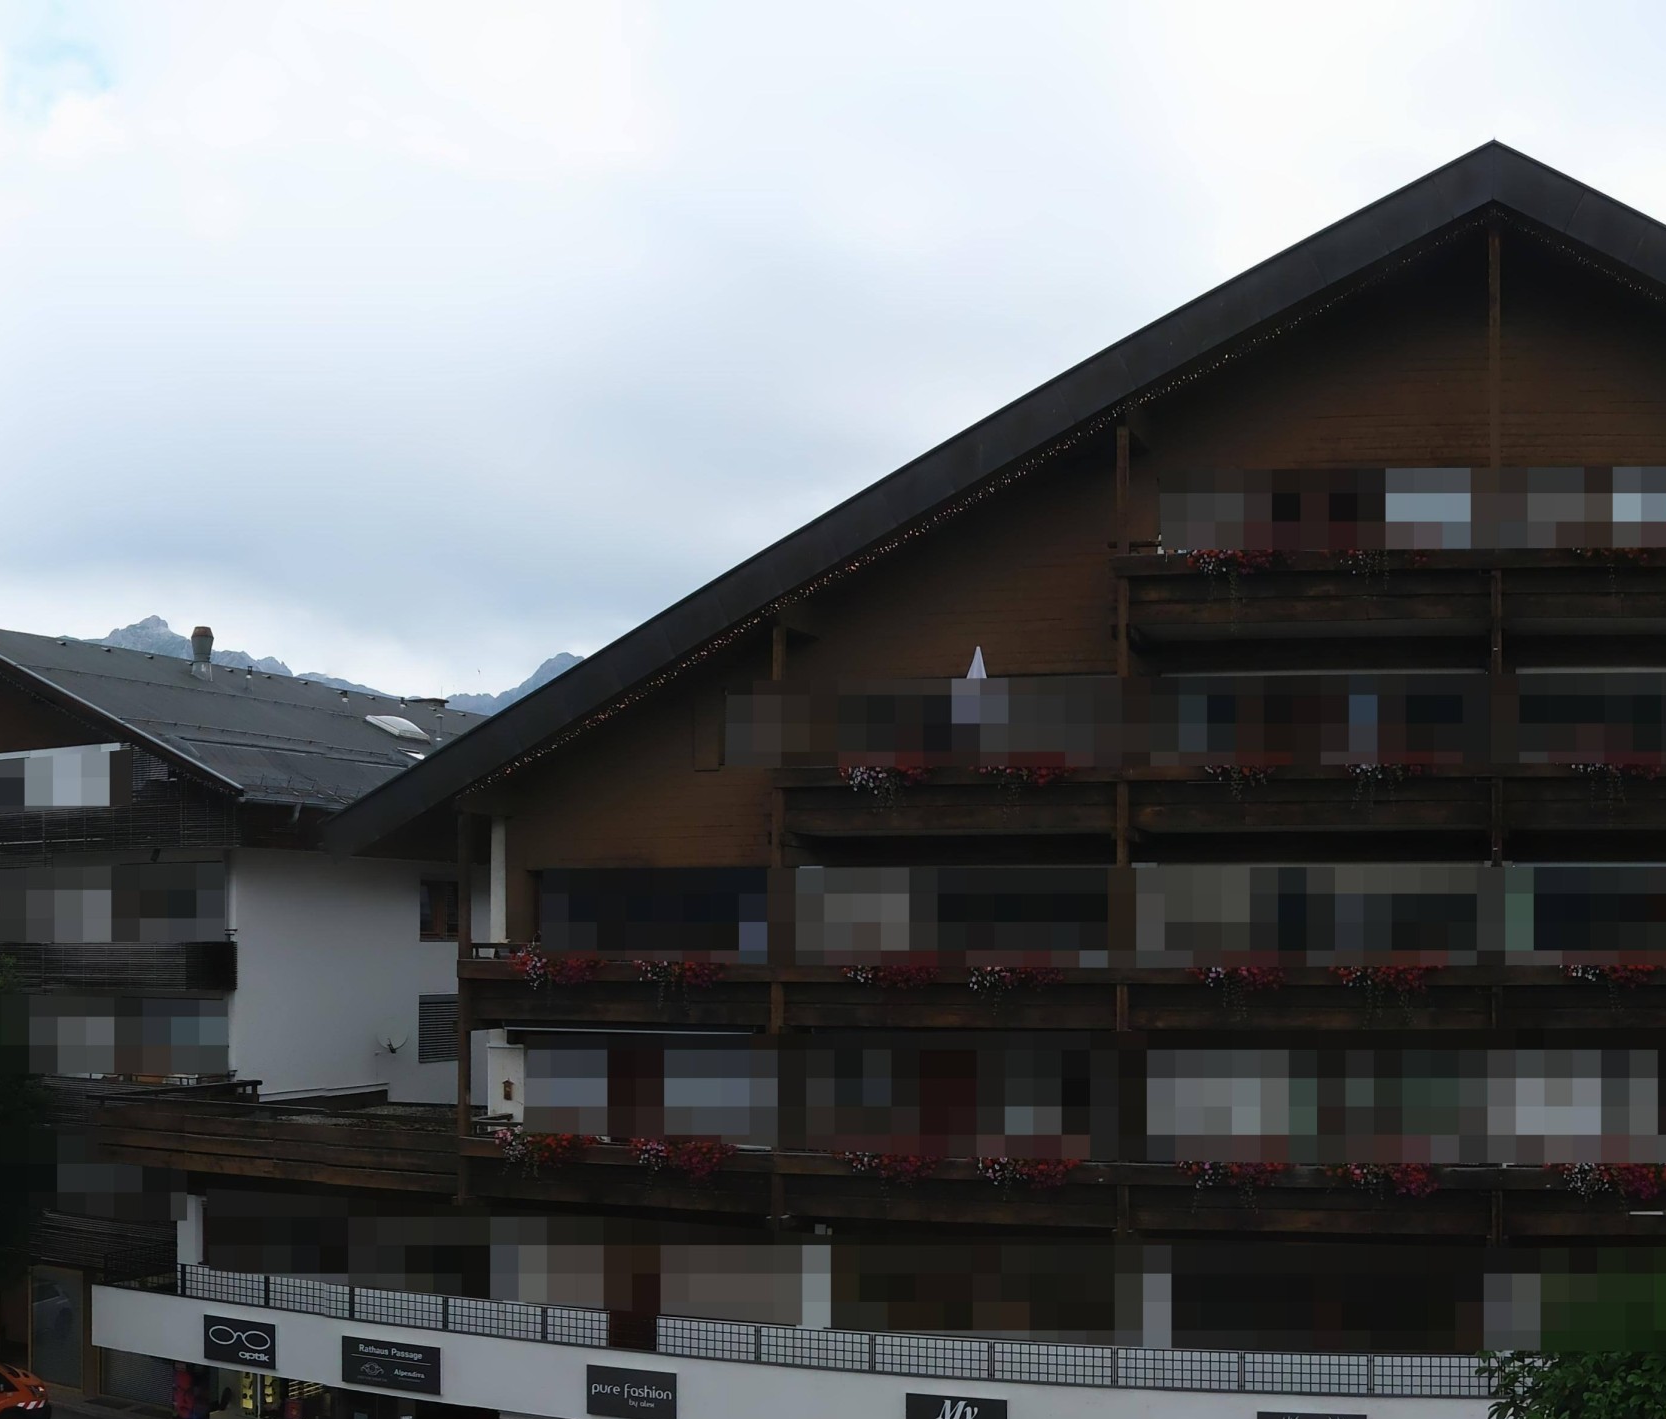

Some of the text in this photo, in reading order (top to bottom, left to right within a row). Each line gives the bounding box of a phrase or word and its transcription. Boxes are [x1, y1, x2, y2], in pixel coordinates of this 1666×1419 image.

[238, 1351, 270, 1362] optik
[358, 1343, 424, 1361] Rathaus Passage
[591, 1382, 672, 1400] pure fashion
